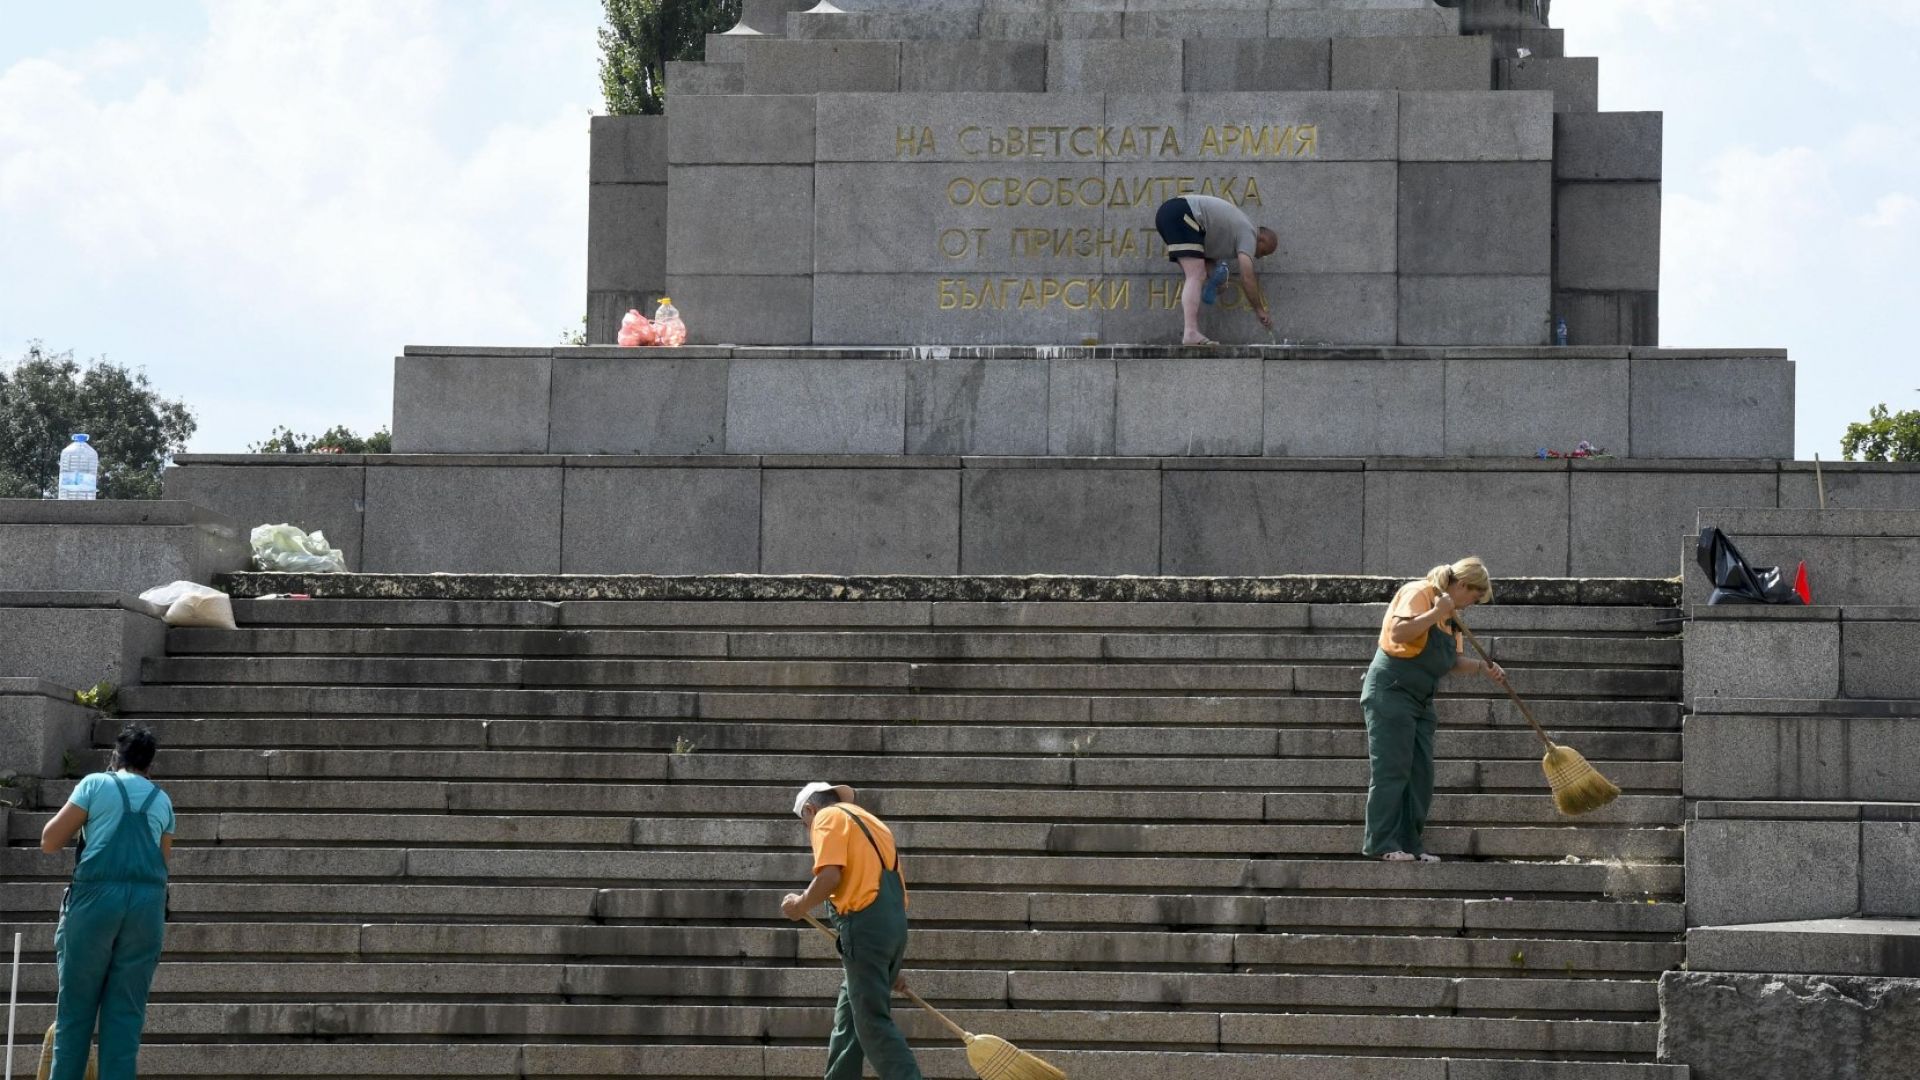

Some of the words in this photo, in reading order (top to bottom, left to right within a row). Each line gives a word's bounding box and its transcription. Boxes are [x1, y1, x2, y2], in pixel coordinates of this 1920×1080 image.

[896, 126, 935, 156] НА
[1201, 125, 1318, 156] АРМИЯ
[948, 177, 1262, 208] ОСВОБОДИТЕЛКА
[939, 228, 991, 258] ОТ
[1011, 228, 1169, 259] ПРИЗНАТ
[939, 279, 1130, 310] БЪЛГАРСКИ
